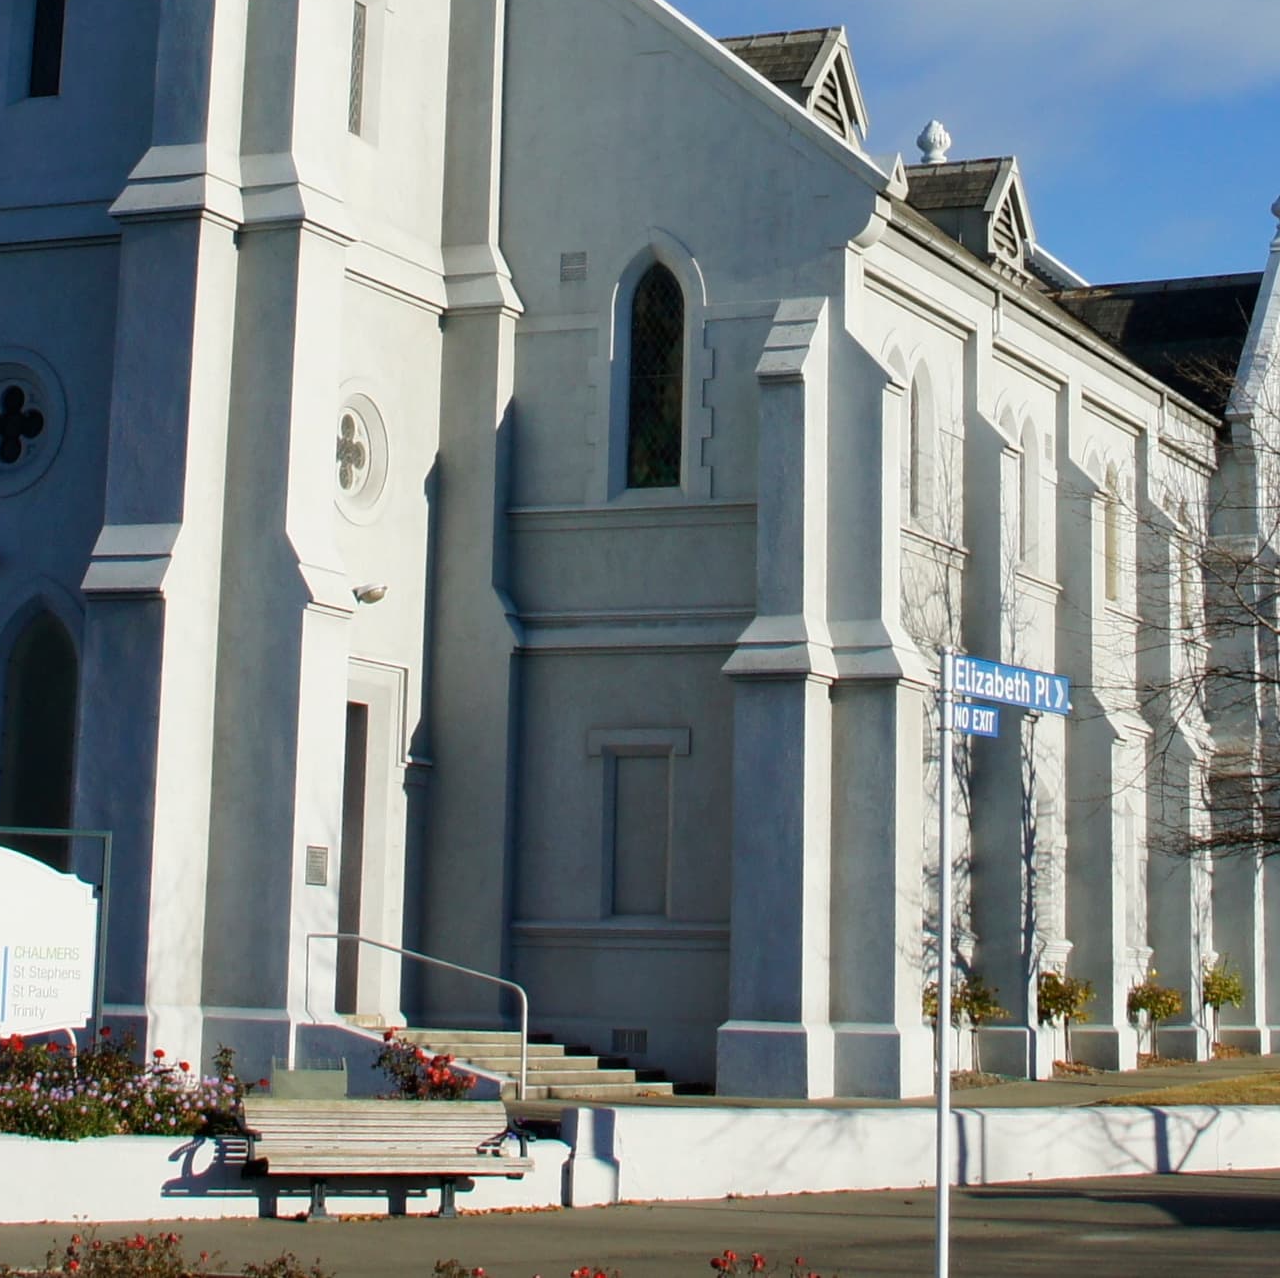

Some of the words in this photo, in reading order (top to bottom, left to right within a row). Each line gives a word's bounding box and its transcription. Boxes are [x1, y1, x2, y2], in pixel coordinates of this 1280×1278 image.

[955, 658, 1030, 703] Elizabeth
[1035, 674, 1051, 708] Pl
[954, 705, 969, 729] NO
[973, 708, 995, 733] EXIT
[14, 945, 80, 961] CHALMERS
[14, 965, 24, 979] St
[29, 965, 81, 982] Stephens
[12, 984, 23, 998] St
[12, 1003, 46, 1019] Trinity
